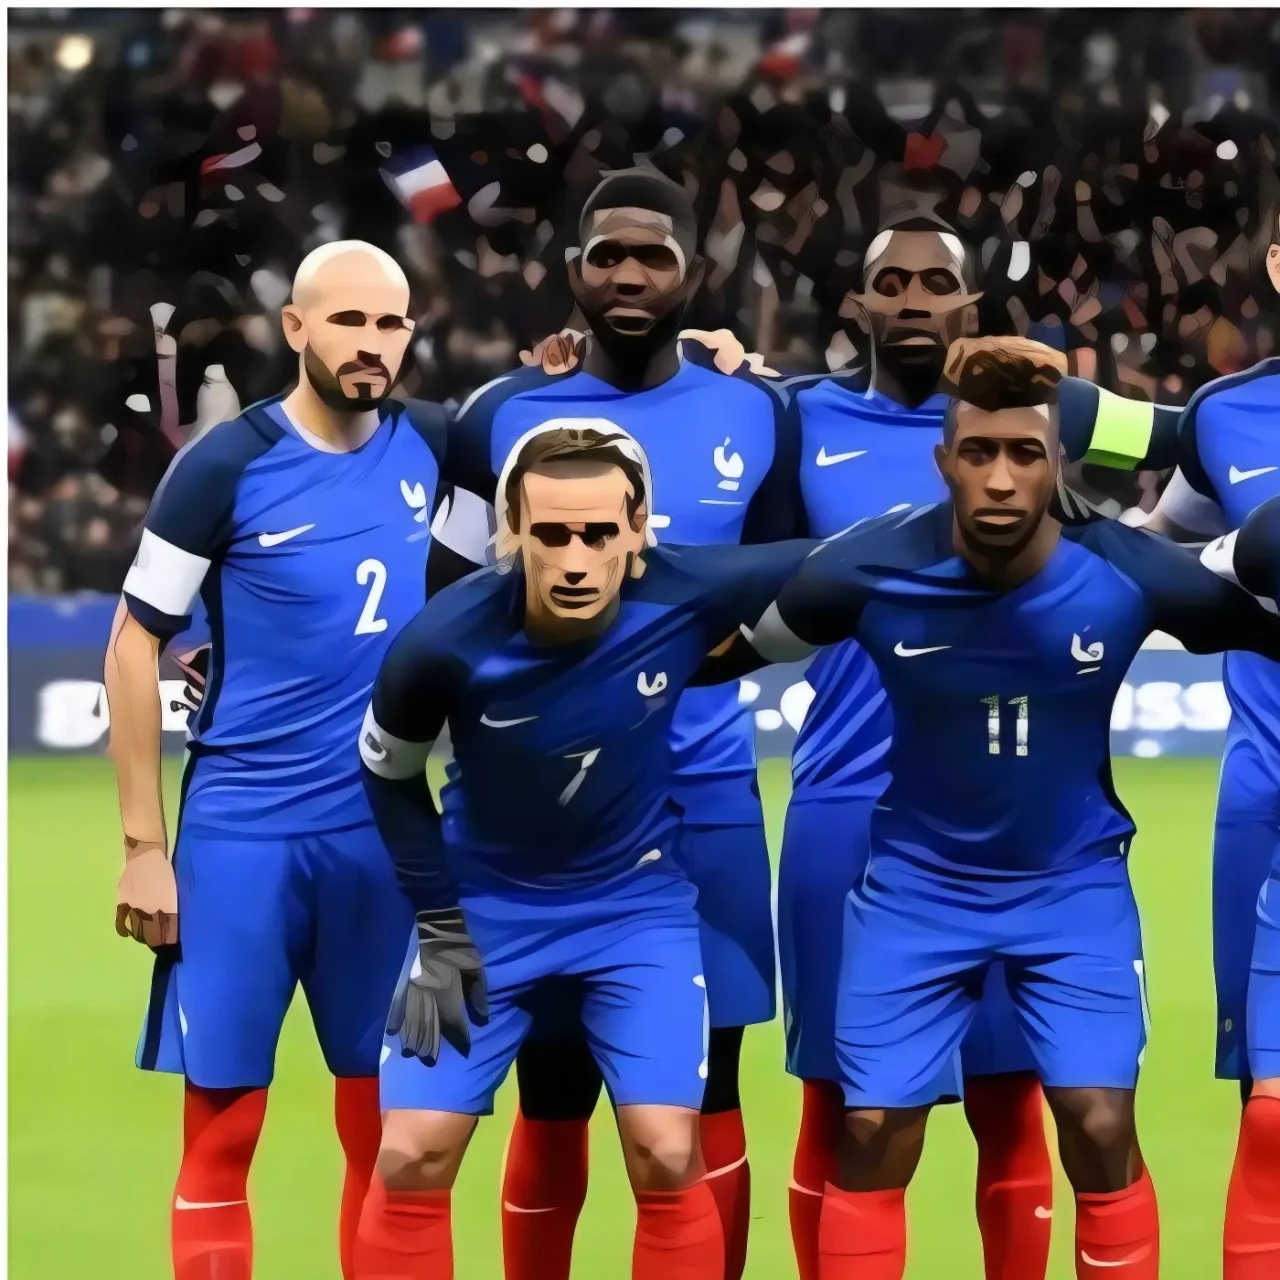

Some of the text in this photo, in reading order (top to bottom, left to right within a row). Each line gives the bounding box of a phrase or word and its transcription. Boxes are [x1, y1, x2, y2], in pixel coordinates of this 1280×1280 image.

[353, 557, 390, 637] 2
[979, 694, 1030, 757] 11
[562, 746, 602, 807] 7
